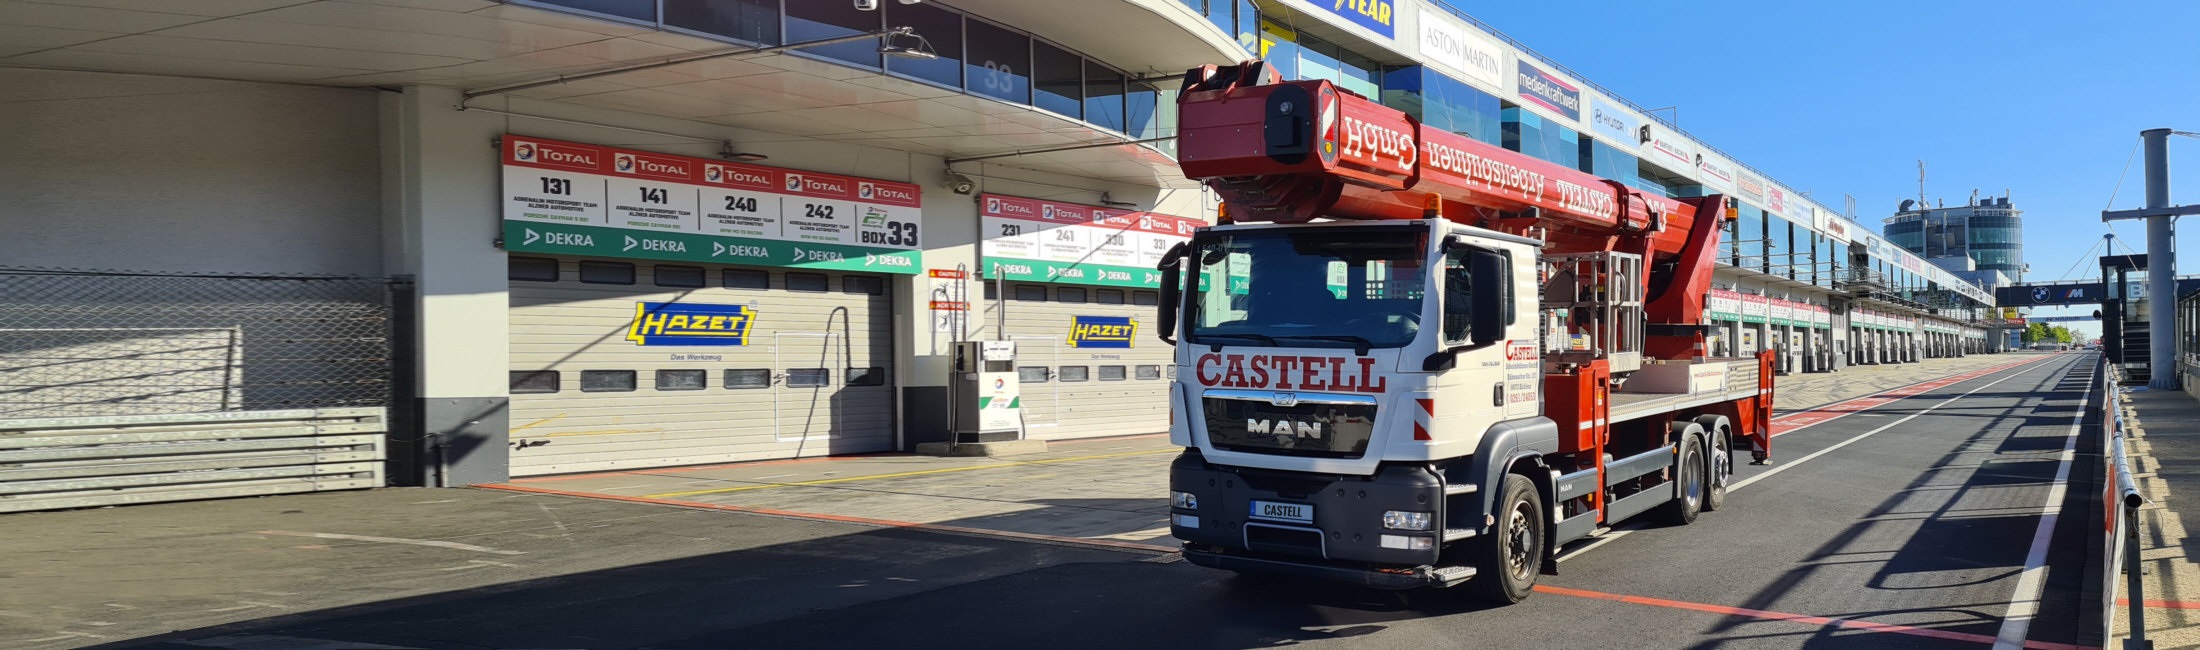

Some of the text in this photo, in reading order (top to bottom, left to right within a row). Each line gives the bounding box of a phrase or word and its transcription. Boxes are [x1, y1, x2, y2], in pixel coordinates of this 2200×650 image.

[1426, 26, 1499, 75] ASTON MARTIN
[984, 60, 1013, 93] 33
[1520, 73, 1579, 112] medienkraftwerk
[1343, 116, 1417, 171] GmbH
[539, 148, 596, 165] TOTAL
[638, 159, 688, 175] TOTAL
[1427, 141, 1545, 203] Arbeitsbühnen
[725, 170, 770, 185] TOTAL
[540, 177, 571, 196] 131
[804, 179, 845, 192] TOTAL
[640, 187, 668, 205] 141
[875, 187, 913, 200] TOTAL
[725, 195, 757, 213] 240
[805, 203, 834, 220] 242
[1001, 202, 1032, 214] TOTAL
[1055, 209, 1084, 219] TOTAL
[1106, 215, 1132, 224] TOTAL
[1001, 224, 1020, 237] 231
[1152, 219, 1172, 230] TOTAL
[545, 233, 594, 247] DEKRA
[862, 230, 887, 245] BOX
[887, 221, 918, 247] 33
[1056, 229, 1074, 242] 241
[643, 239, 687, 252] DEKRA
[729, 245, 769, 258] DEKRA
[1153, 238, 1166, 250] 331
[809, 251, 845, 263] DEKRA
[879, 255, 912, 266] DEKRA
[1004, 264, 1032, 275] DEKRA
[1058, 268, 1084, 278] DEKRA
[1108, 271, 1131, 281] DEKRA
[641, 313, 744, 335] HAZET
[1074, 323, 1132, 340] HAZET
[670, 353, 722, 361] Das Werkzeug
[1506, 339, 1539, 361] CASTELL
[1196, 353, 1386, 394] CASTELL
[1247, 418, 1322, 439] MAN
[1560, 483, 1573, 493] MAN
[1264, 503, 1303, 518] CASTELL
